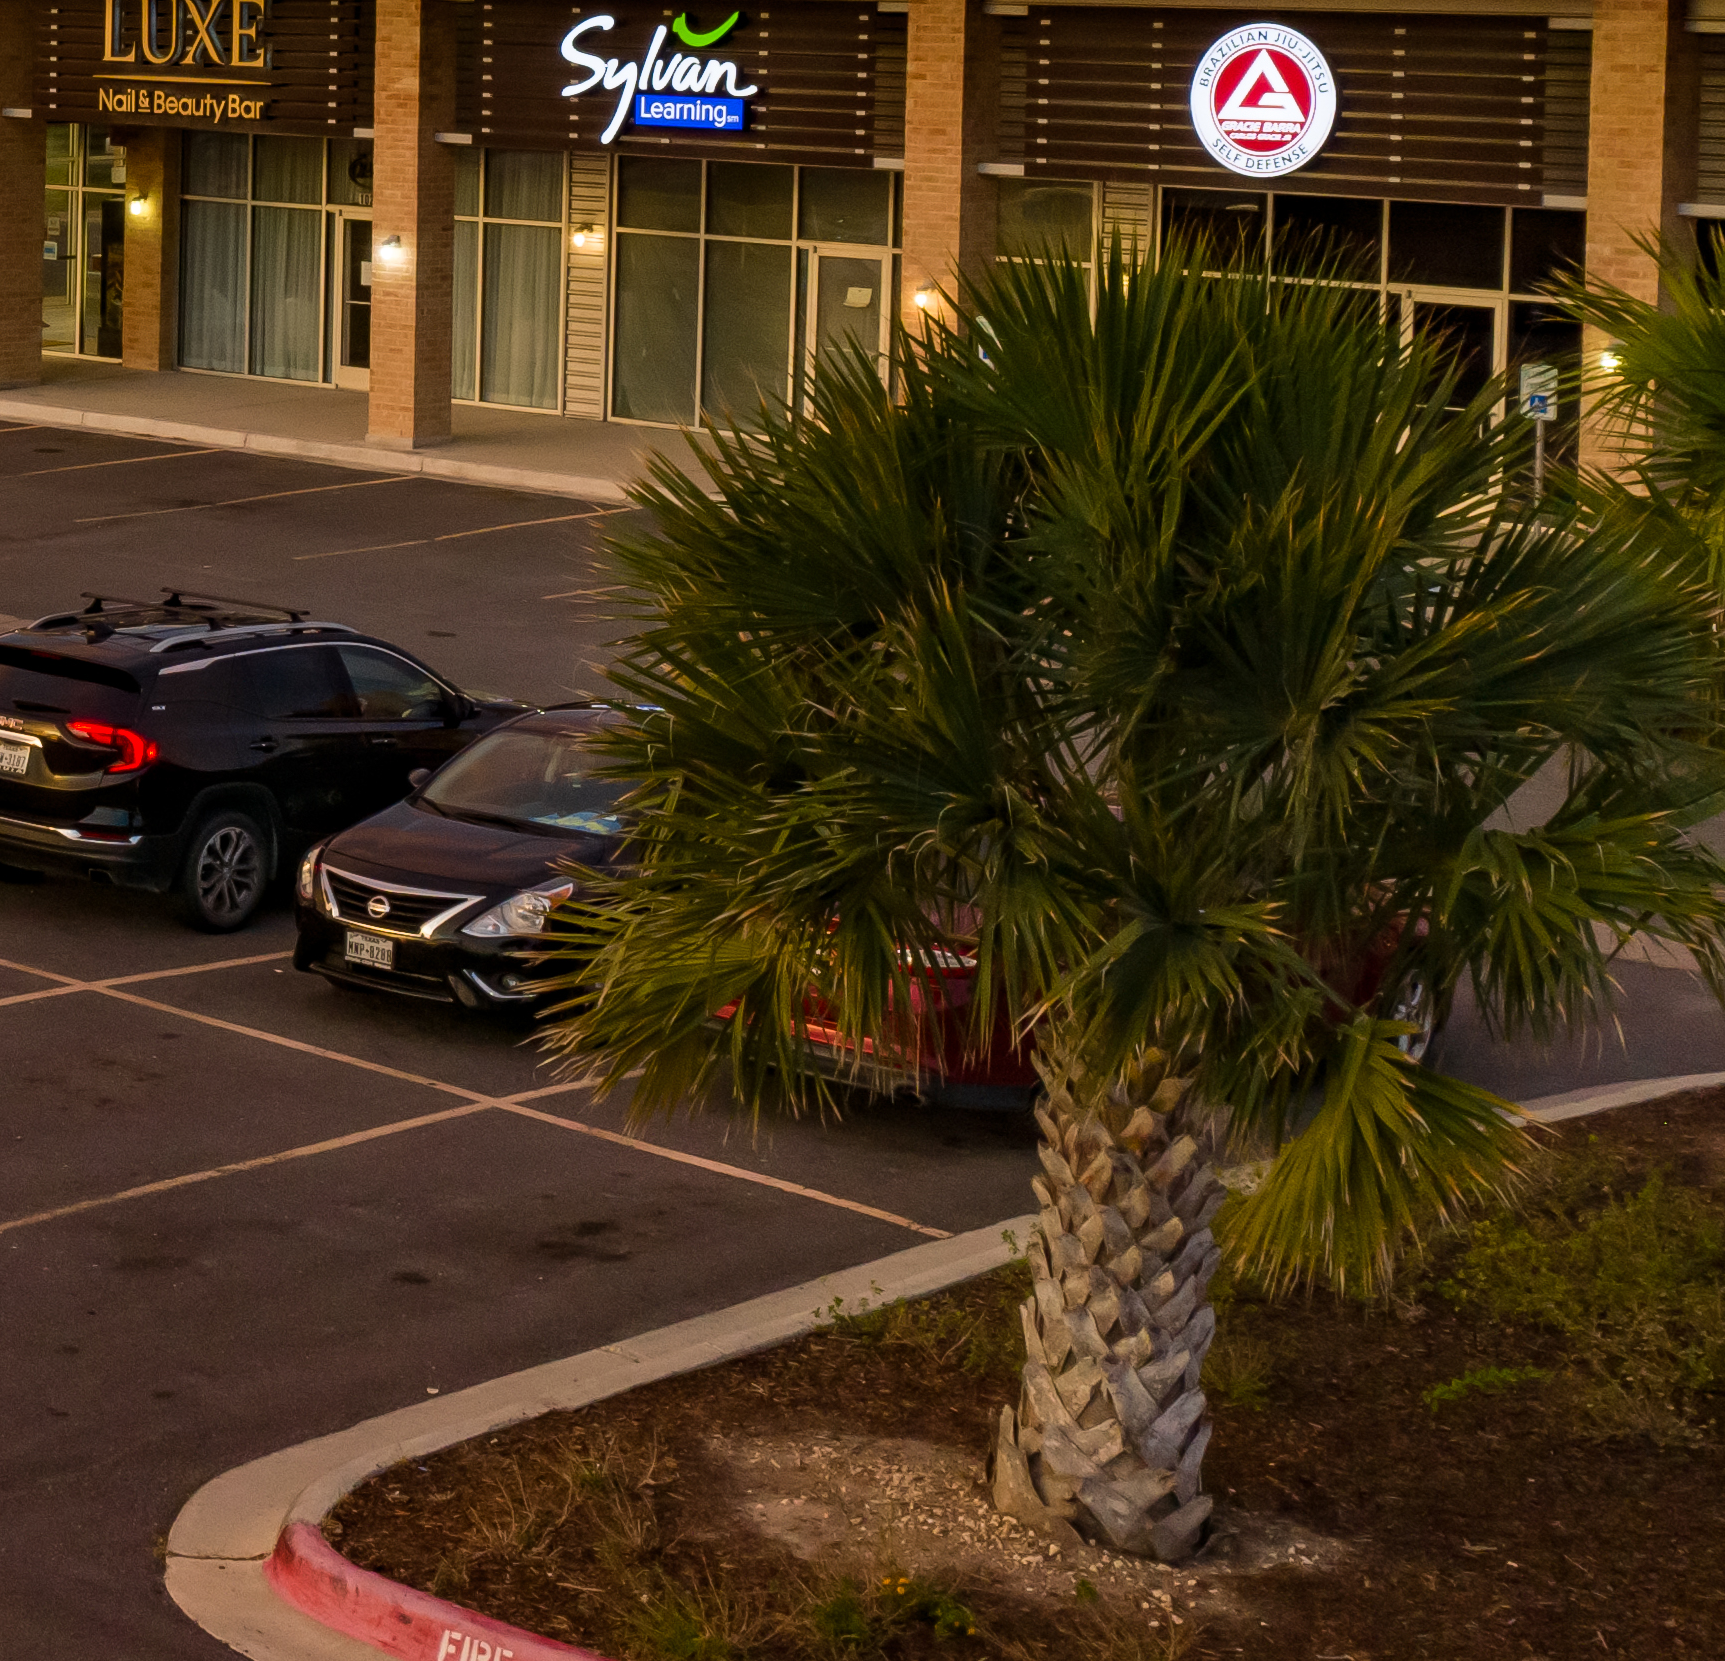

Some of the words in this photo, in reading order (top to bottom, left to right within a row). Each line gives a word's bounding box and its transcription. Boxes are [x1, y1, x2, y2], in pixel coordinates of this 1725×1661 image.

[1199, 30, 1268, 87] BRAZILIAN
[1274, 32, 1329, 94] JIU-JITSU
[561, 14, 758, 145] Sylvan
[99, 88, 135, 113] Nail
[138, 89, 151, 113] &
[154, 90, 226, 124] Beauty
[228, 94, 264, 119] Bar
[640, 96, 727, 128] Learning
[1221, 121, 1261, 132] GRACIE
[1262, 122, 1301, 134] BARRA
[1212, 138, 1242, 163] SELF
[1245, 143, 1309, 170] DEFENSE
